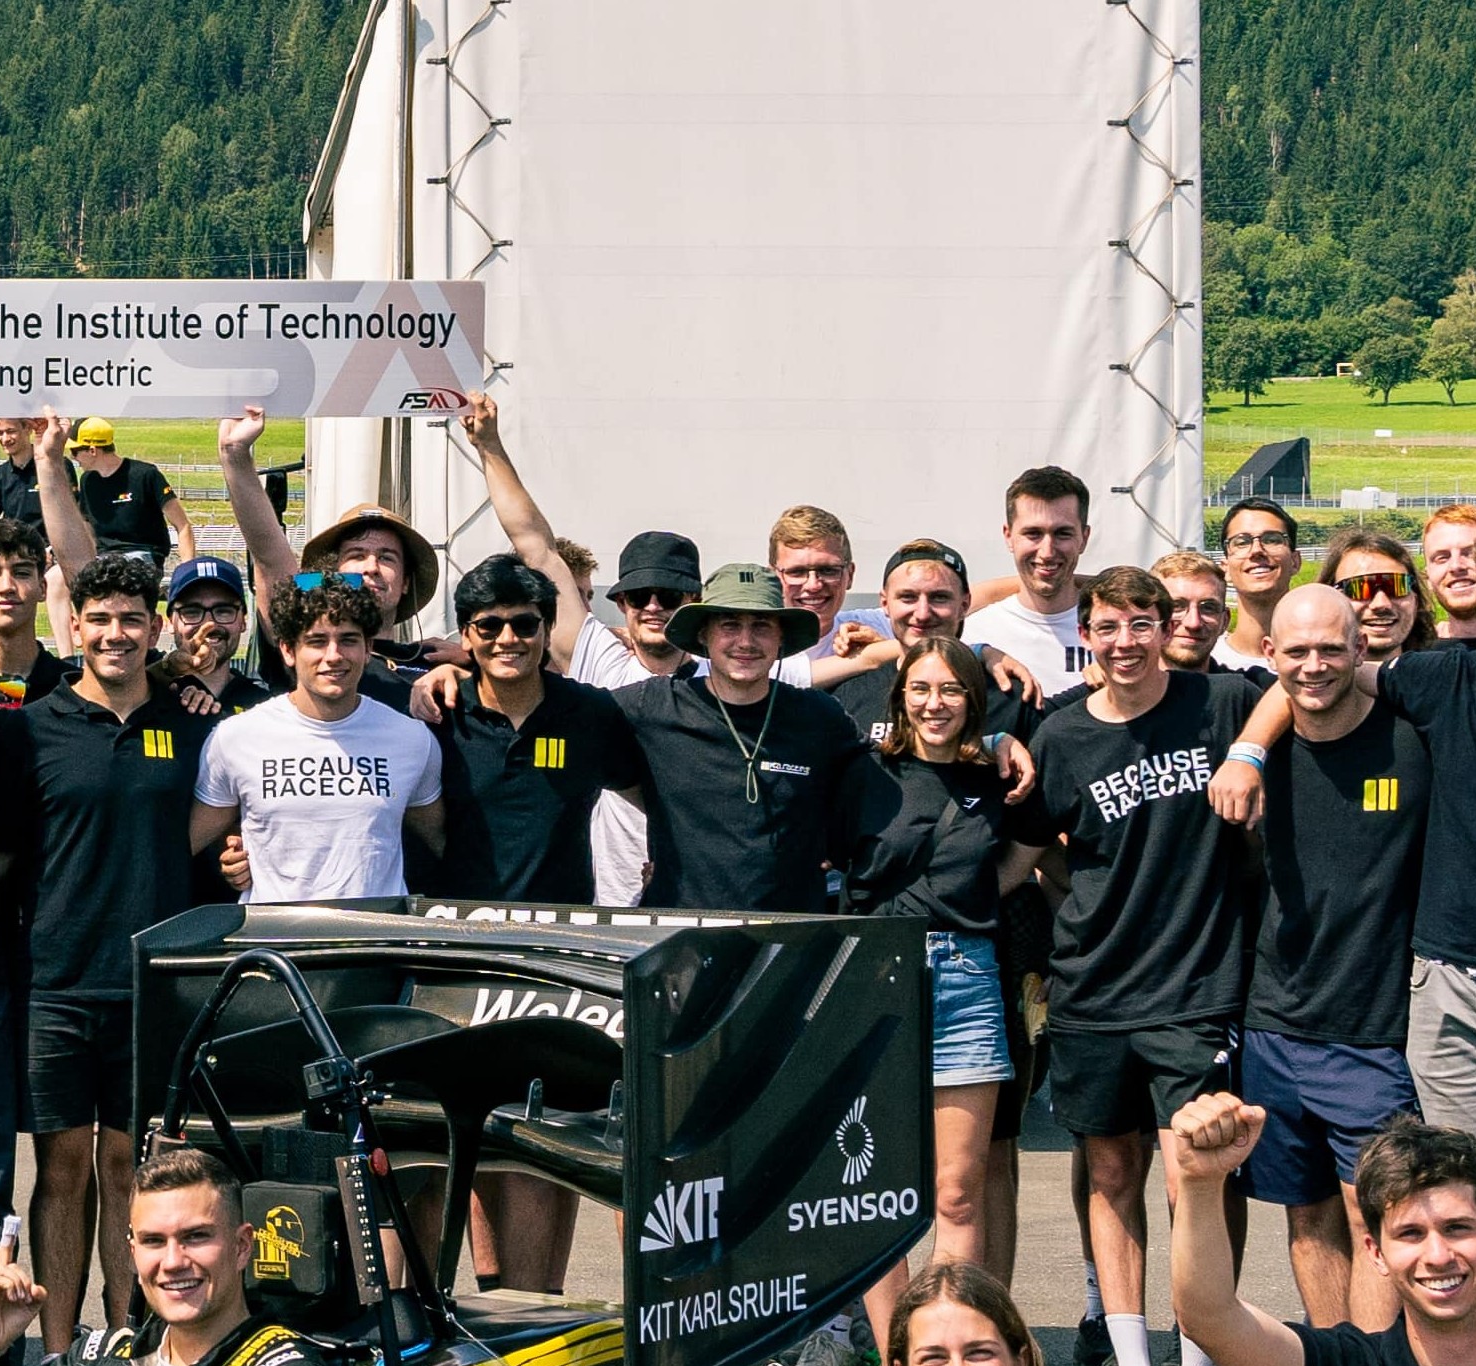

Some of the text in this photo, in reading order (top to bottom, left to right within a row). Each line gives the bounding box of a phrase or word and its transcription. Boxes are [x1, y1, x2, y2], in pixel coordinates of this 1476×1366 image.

[56, 303, 202, 339] Institute
[215, 303, 248, 339] of
[258, 303, 457, 348] Technology
[45, 357, 152, 387] Electric
[262, 756, 391, 779] BECAUSE
[1088, 747, 1210, 804] BECAUSE
[670, 1176, 725, 1244] KIT
[787, 1187, 919, 1233] SYENSQO
[639, 1274, 809, 1344] KIT KARLSRUHE
